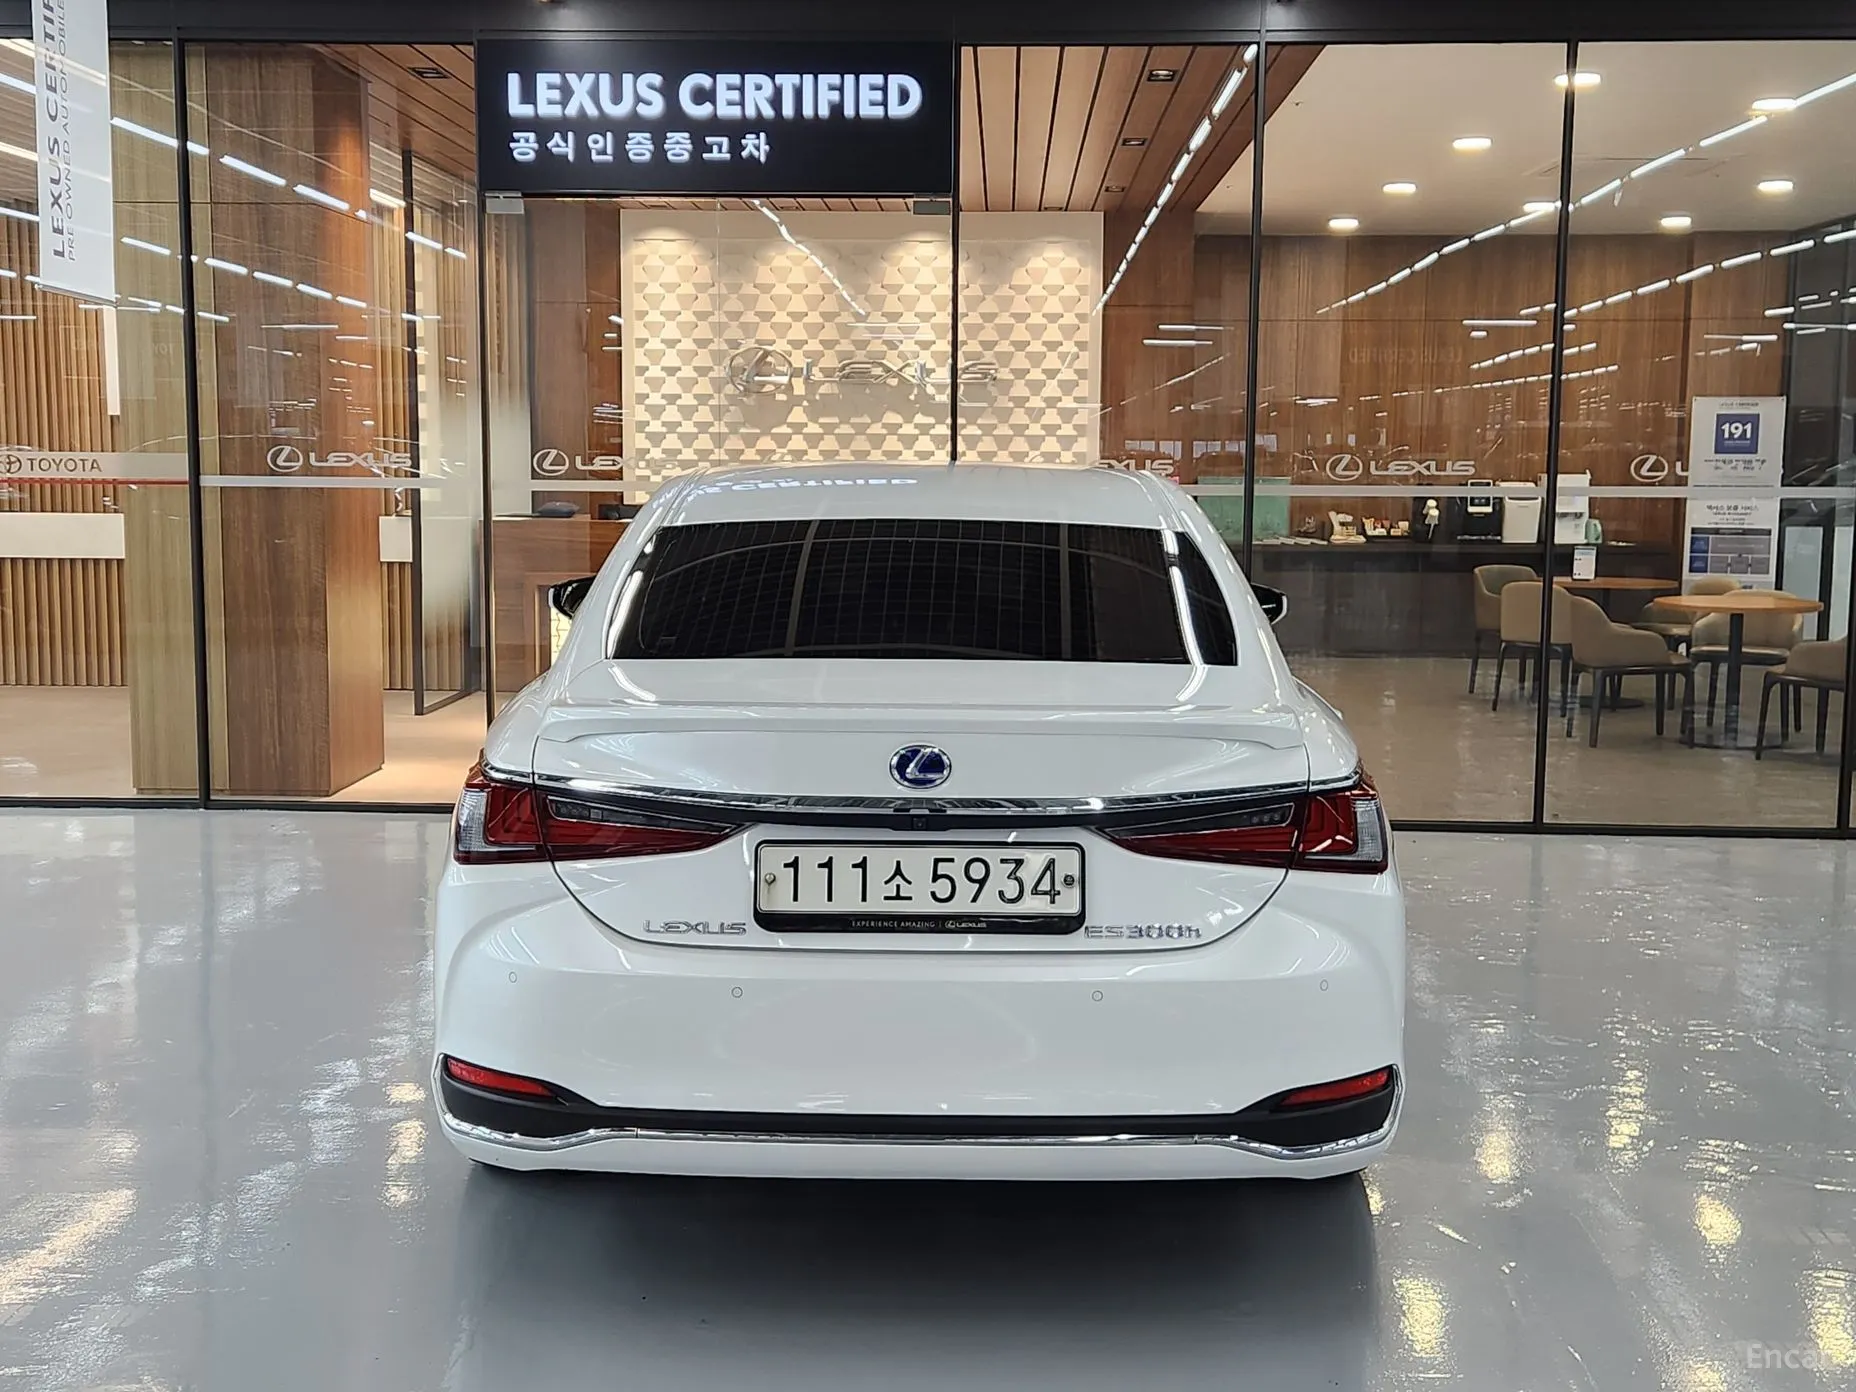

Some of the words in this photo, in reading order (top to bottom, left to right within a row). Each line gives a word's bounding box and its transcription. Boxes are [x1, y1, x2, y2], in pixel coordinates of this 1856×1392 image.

[507, 72, 666, 119] LEXUS
[678, 72, 923, 119] CERTIFIED
[62, 140, 73, 220] OWNED
[48, 135, 66, 259] LEXUS
[67, 227, 76, 261] PRE
[803, 358, 998, 384] LEXUS
[1721, 422, 1752, 439] 191
[27, 457, 102, 472] TOYOTA
[309, 452, 413, 467] LEXUS
[1370, 460, 1476, 476] LEXUS
[781, 855, 914, 904] 111소
[930, 856, 1061, 905] 5934
[643, 919, 747, 935] LEXUS
[852, 920, 898, 928] EXPERIENCE
[900, 920, 936, 928] AMAZING
